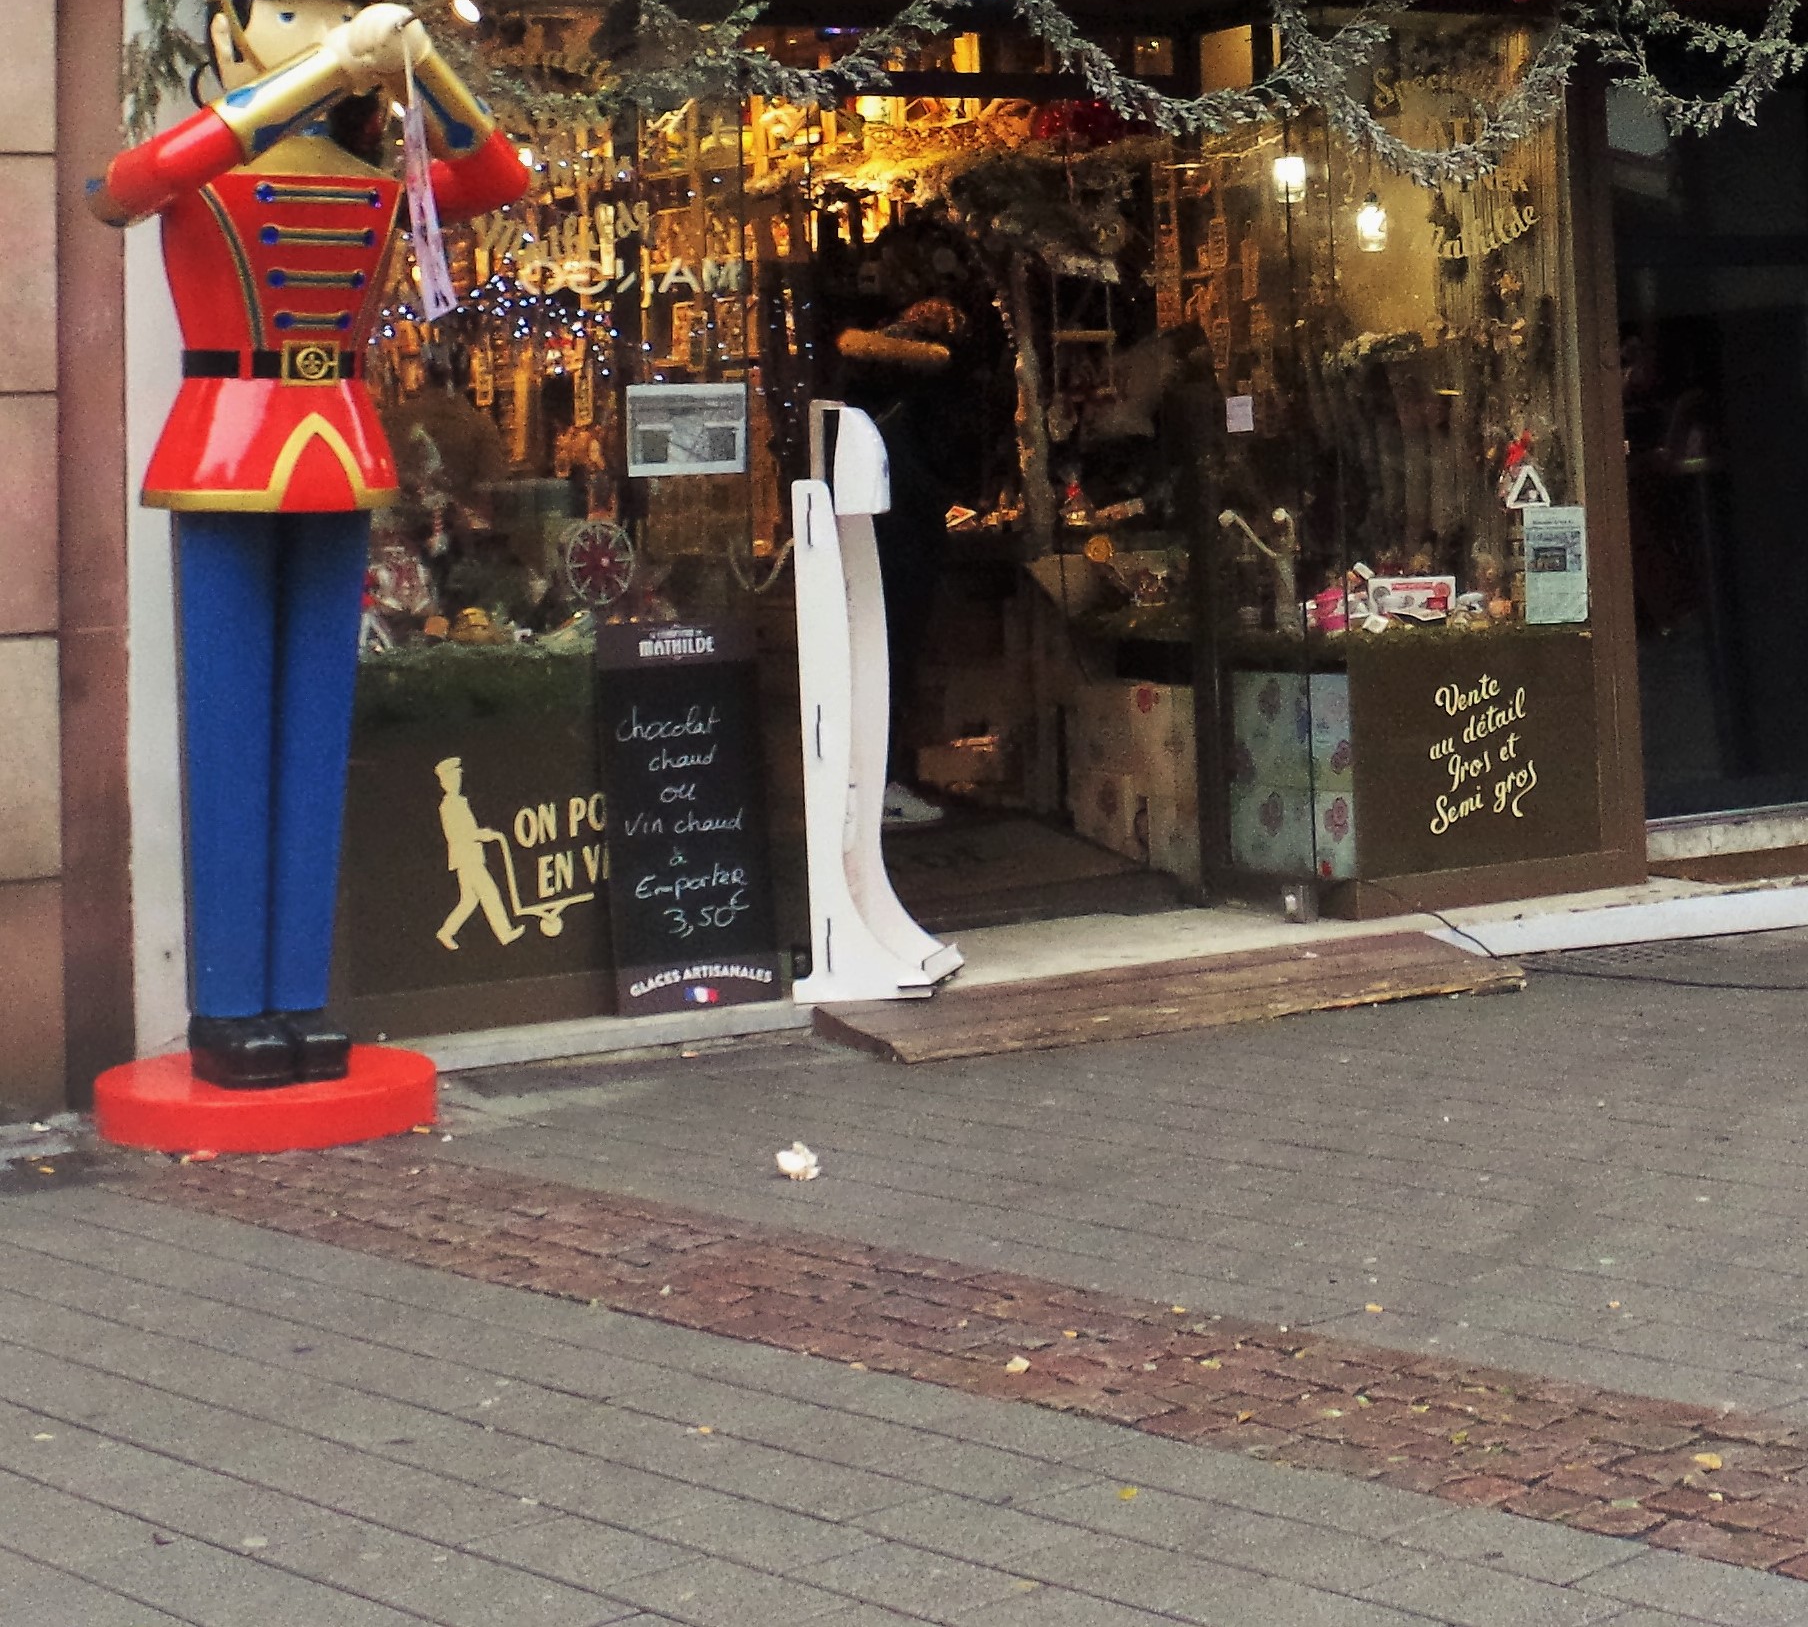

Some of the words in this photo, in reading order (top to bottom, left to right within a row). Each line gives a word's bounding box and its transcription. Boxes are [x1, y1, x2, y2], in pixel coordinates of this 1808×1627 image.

[639, 635, 716, 658] MATHILDE
[1434, 673, 1500, 717] Vente
[1429, 737, 1455, 761] au
[1462, 686, 1527, 745] détail
[648, 743, 719, 772] chaud
[1499, 732, 1523, 763] et
[1429, 784, 1485, 836] Semi
[1492, 759, 1539, 819] gros
[513, 802, 556, 849] ON
[674, 806, 744, 835] chaud
[537, 850, 575, 899] EN
[662, 890, 750, 939] 3,50€
[629, 967, 682, 998] GLACES
[682, 963, 773, 985] ARTISANALES
